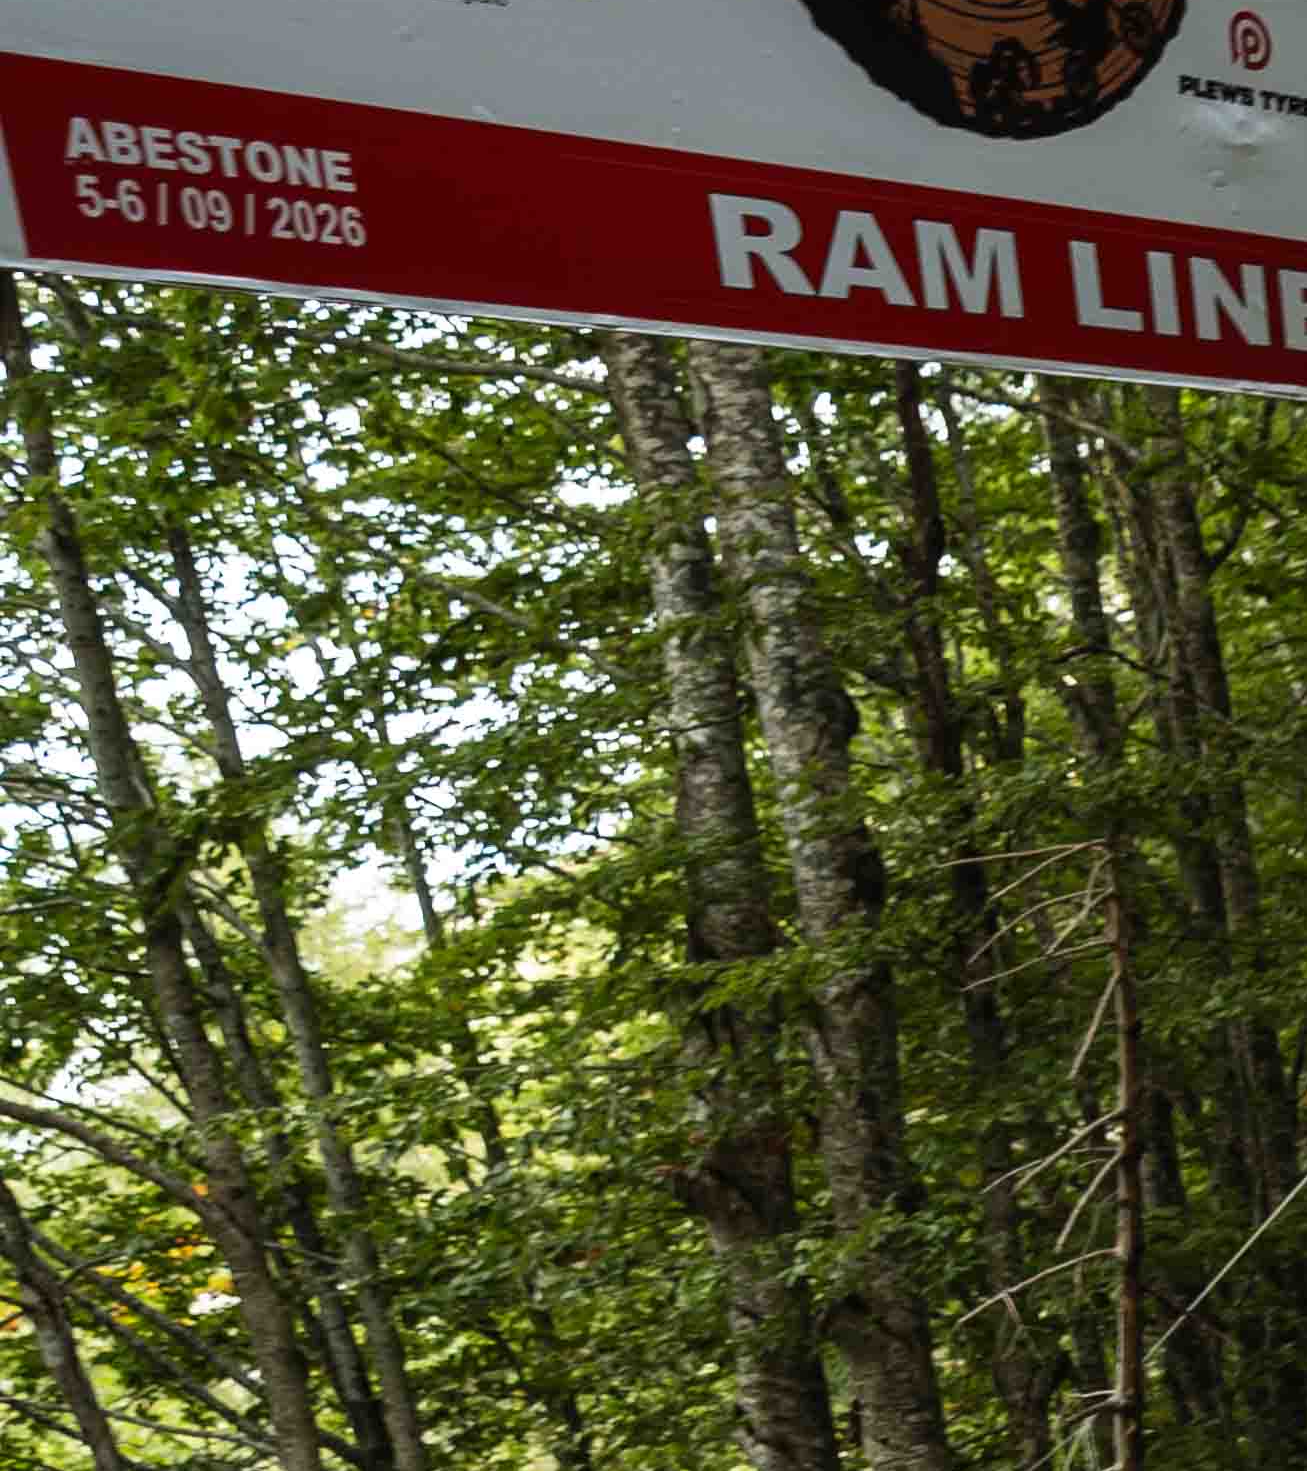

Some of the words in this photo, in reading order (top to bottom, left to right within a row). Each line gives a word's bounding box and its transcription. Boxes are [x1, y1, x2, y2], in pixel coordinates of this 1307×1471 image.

[1178, 75, 1255, 111] PLEWS
[64, 116, 357, 195] ABESTONE
[75, 175, 147, 224] 5-6
[181, 185, 233, 234] 09
[269, 196, 367, 248] 2026
[708, 193, 1025, 319] RAM
